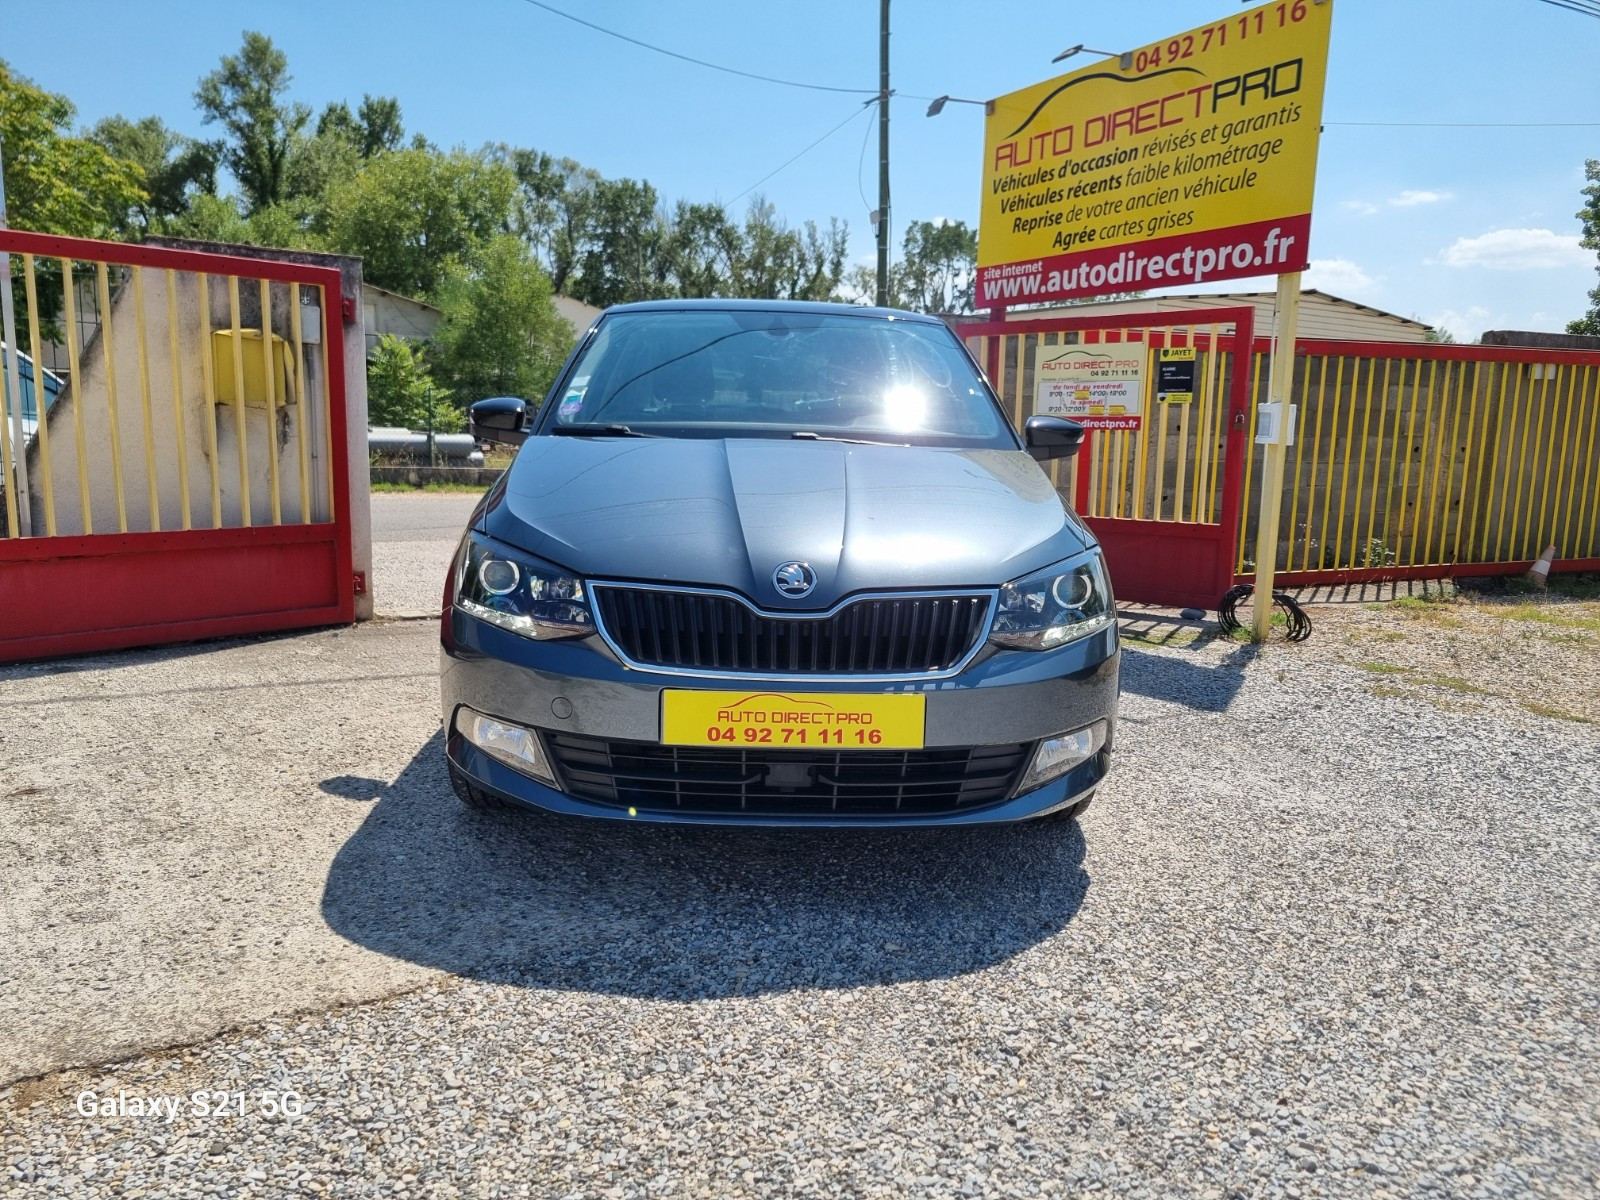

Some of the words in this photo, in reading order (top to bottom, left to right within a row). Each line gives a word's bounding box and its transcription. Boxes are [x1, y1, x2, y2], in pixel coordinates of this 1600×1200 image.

[1136, 46, 1161, 73] 04
[1167, 35, 1194, 63] 92
[1201, 23, 1227, 52] 71
[1238, 10, 1264, 40] 11
[1276, 0, 1307, 28] 16
[993, 167, 1055, 195] Véhicules
[1057, 146, 1139, 179] d'occasion
[1142, 129, 1197, 158] révisés
[1200, 124, 1219, 144] et
[1221, 102, 1302, 145] garantis
[995, 125, 1074, 172] AUTO
[1001, 187, 1064, 215] Véhicules
[1066, 173, 1122, 200] récents
[1125, 161, 1170, 187] faible
[1173, 138, 1284, 178] kilométrage
[1012, 210, 1063, 235] Reprise
[1065, 204, 1083, 224] de
[1086, 199, 1123, 219] votre
[1125, 187, 1179, 212] ancien
[1183, 167, 1257, 200] véhicule
[1052, 225, 1096, 251] Agrée
[1099, 219, 1144, 241] cartes
[1147, 210, 1195, 237] grises
[983, 227, 1295, 301] www.autodirectpro.fr
[983, 265, 1000, 280] site
[1002, 260, 1043, 275] internet
[1042, 362, 1071, 371] AUTO
[1073, 360, 1114, 370] DIRECT
[1115, 359, 1139, 368] PRO
[1078, 419, 1138, 430] directpro.fr
[707, 727, 736, 742] 04
[743, 727, 773, 743] 92
[780, 728, 807, 743] 71
[817, 729, 843, 744] 11
[854, 729, 882, 744] 16
[717, 710, 766, 723] AUTO
